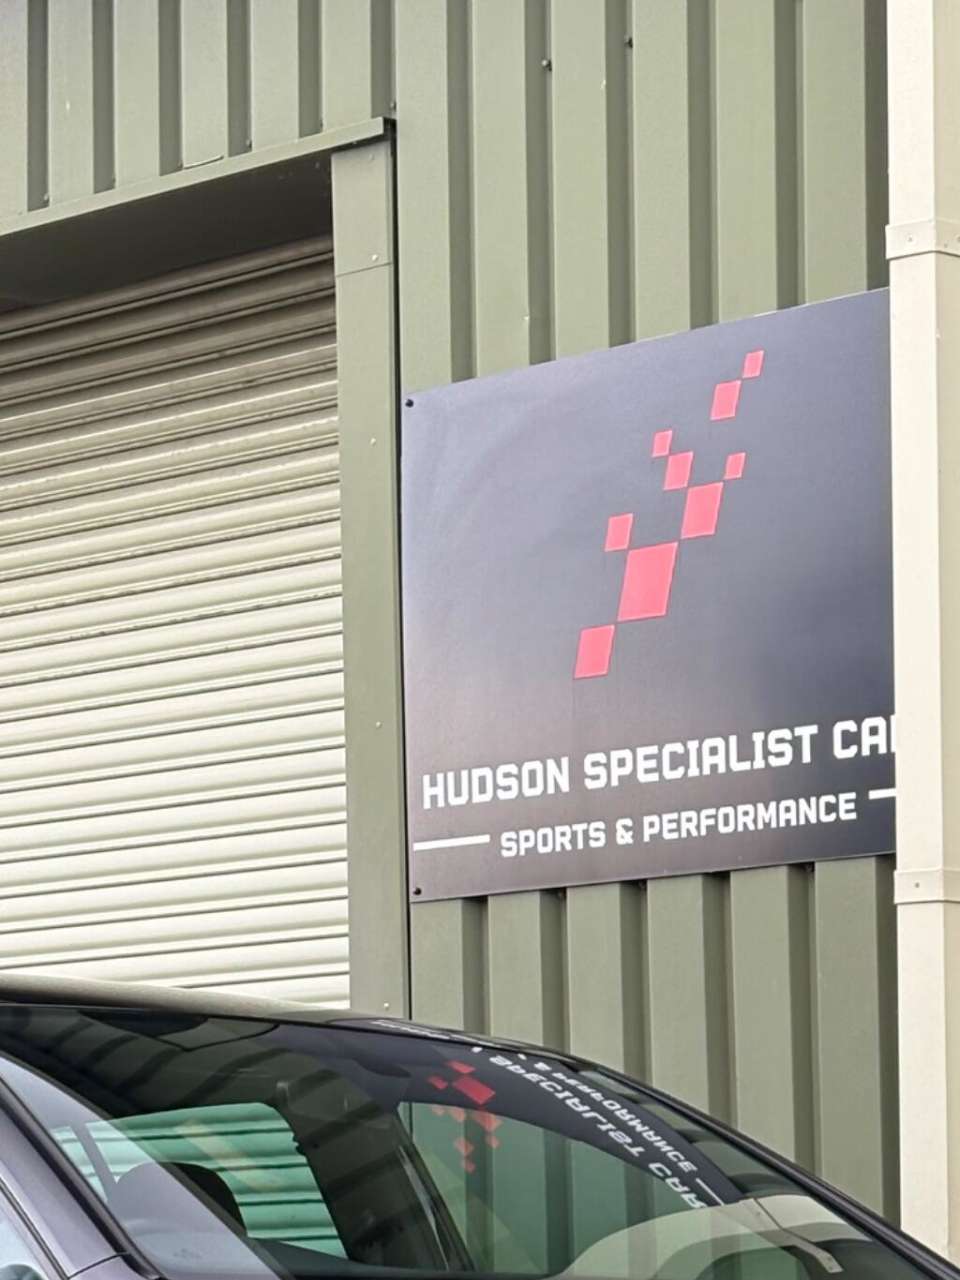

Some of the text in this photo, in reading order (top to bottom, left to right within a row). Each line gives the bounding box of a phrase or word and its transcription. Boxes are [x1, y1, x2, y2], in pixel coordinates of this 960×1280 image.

[422, 757, 571, 811] HUDSON
[583, 724, 819, 790] SPECIALIST
[499, 792, 857, 858] SPORTS & PERFORMANCE
